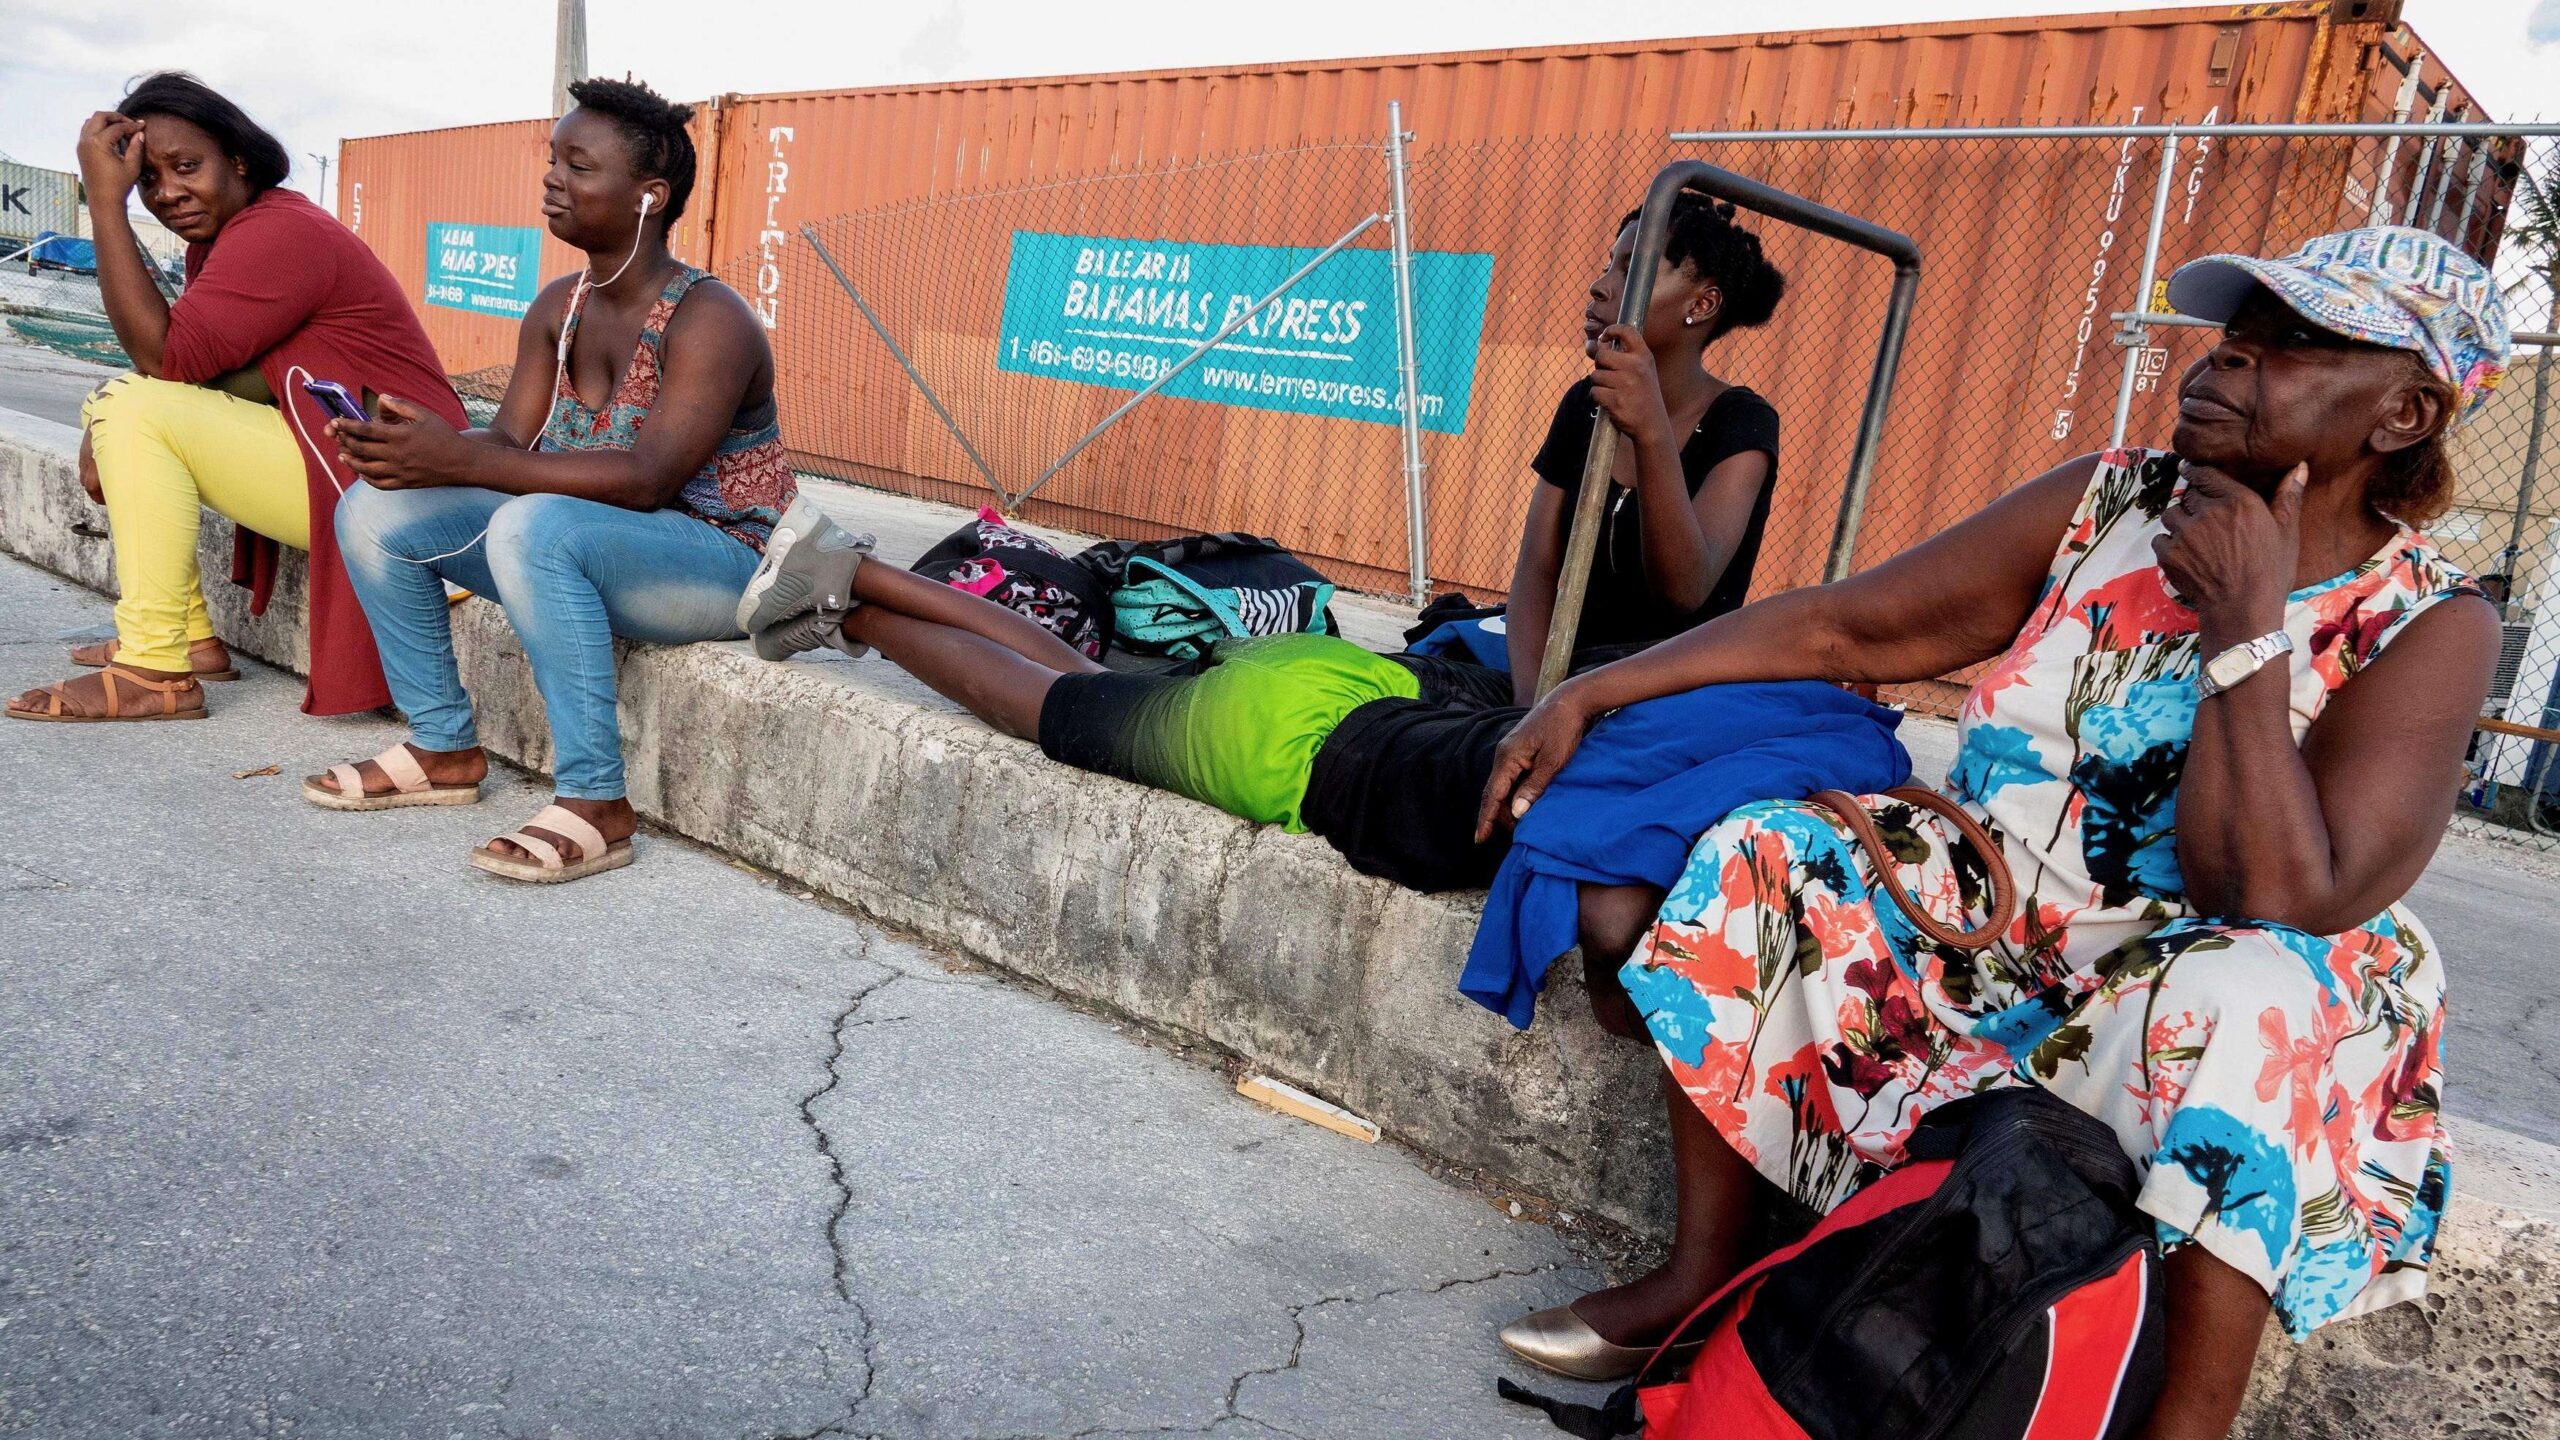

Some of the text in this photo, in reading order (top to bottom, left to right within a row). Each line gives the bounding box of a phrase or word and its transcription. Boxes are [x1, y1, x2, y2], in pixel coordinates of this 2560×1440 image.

[2, 183, 32, 215] K
[1063, 279, 1368, 344] BAHAMAS EXPRESS
[1202, 366, 1444, 417] www.erryexpress.cm
[2135, 376, 2158, 392] 81
